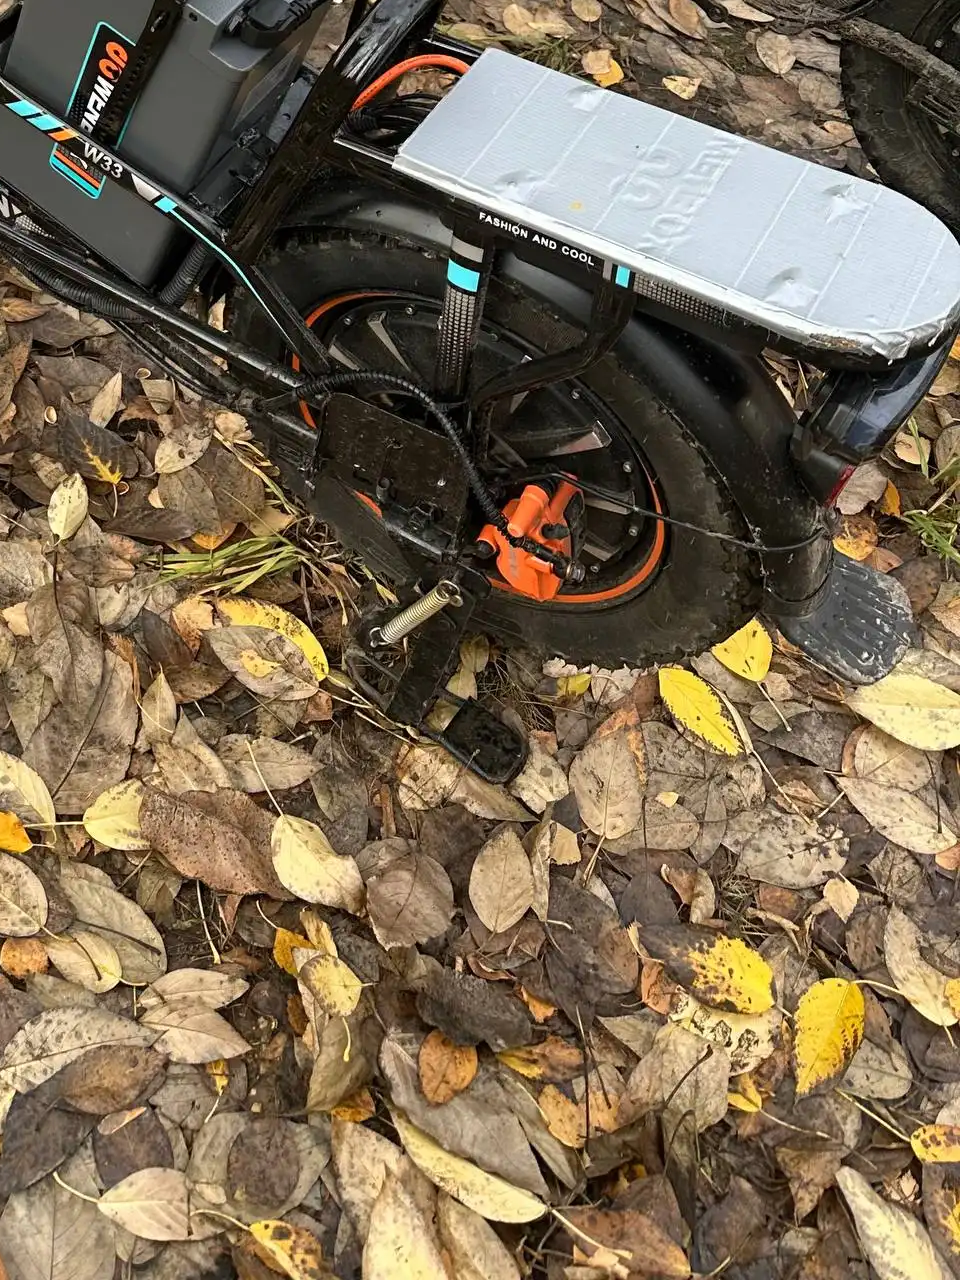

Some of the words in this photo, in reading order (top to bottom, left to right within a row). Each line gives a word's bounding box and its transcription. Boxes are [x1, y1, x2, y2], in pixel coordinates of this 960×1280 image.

[84, 142, 123, 179] W33
[479, 212, 528, 239] FASHION
[532, 234, 557, 250] AND
[561, 245, 595, 266] COOL
